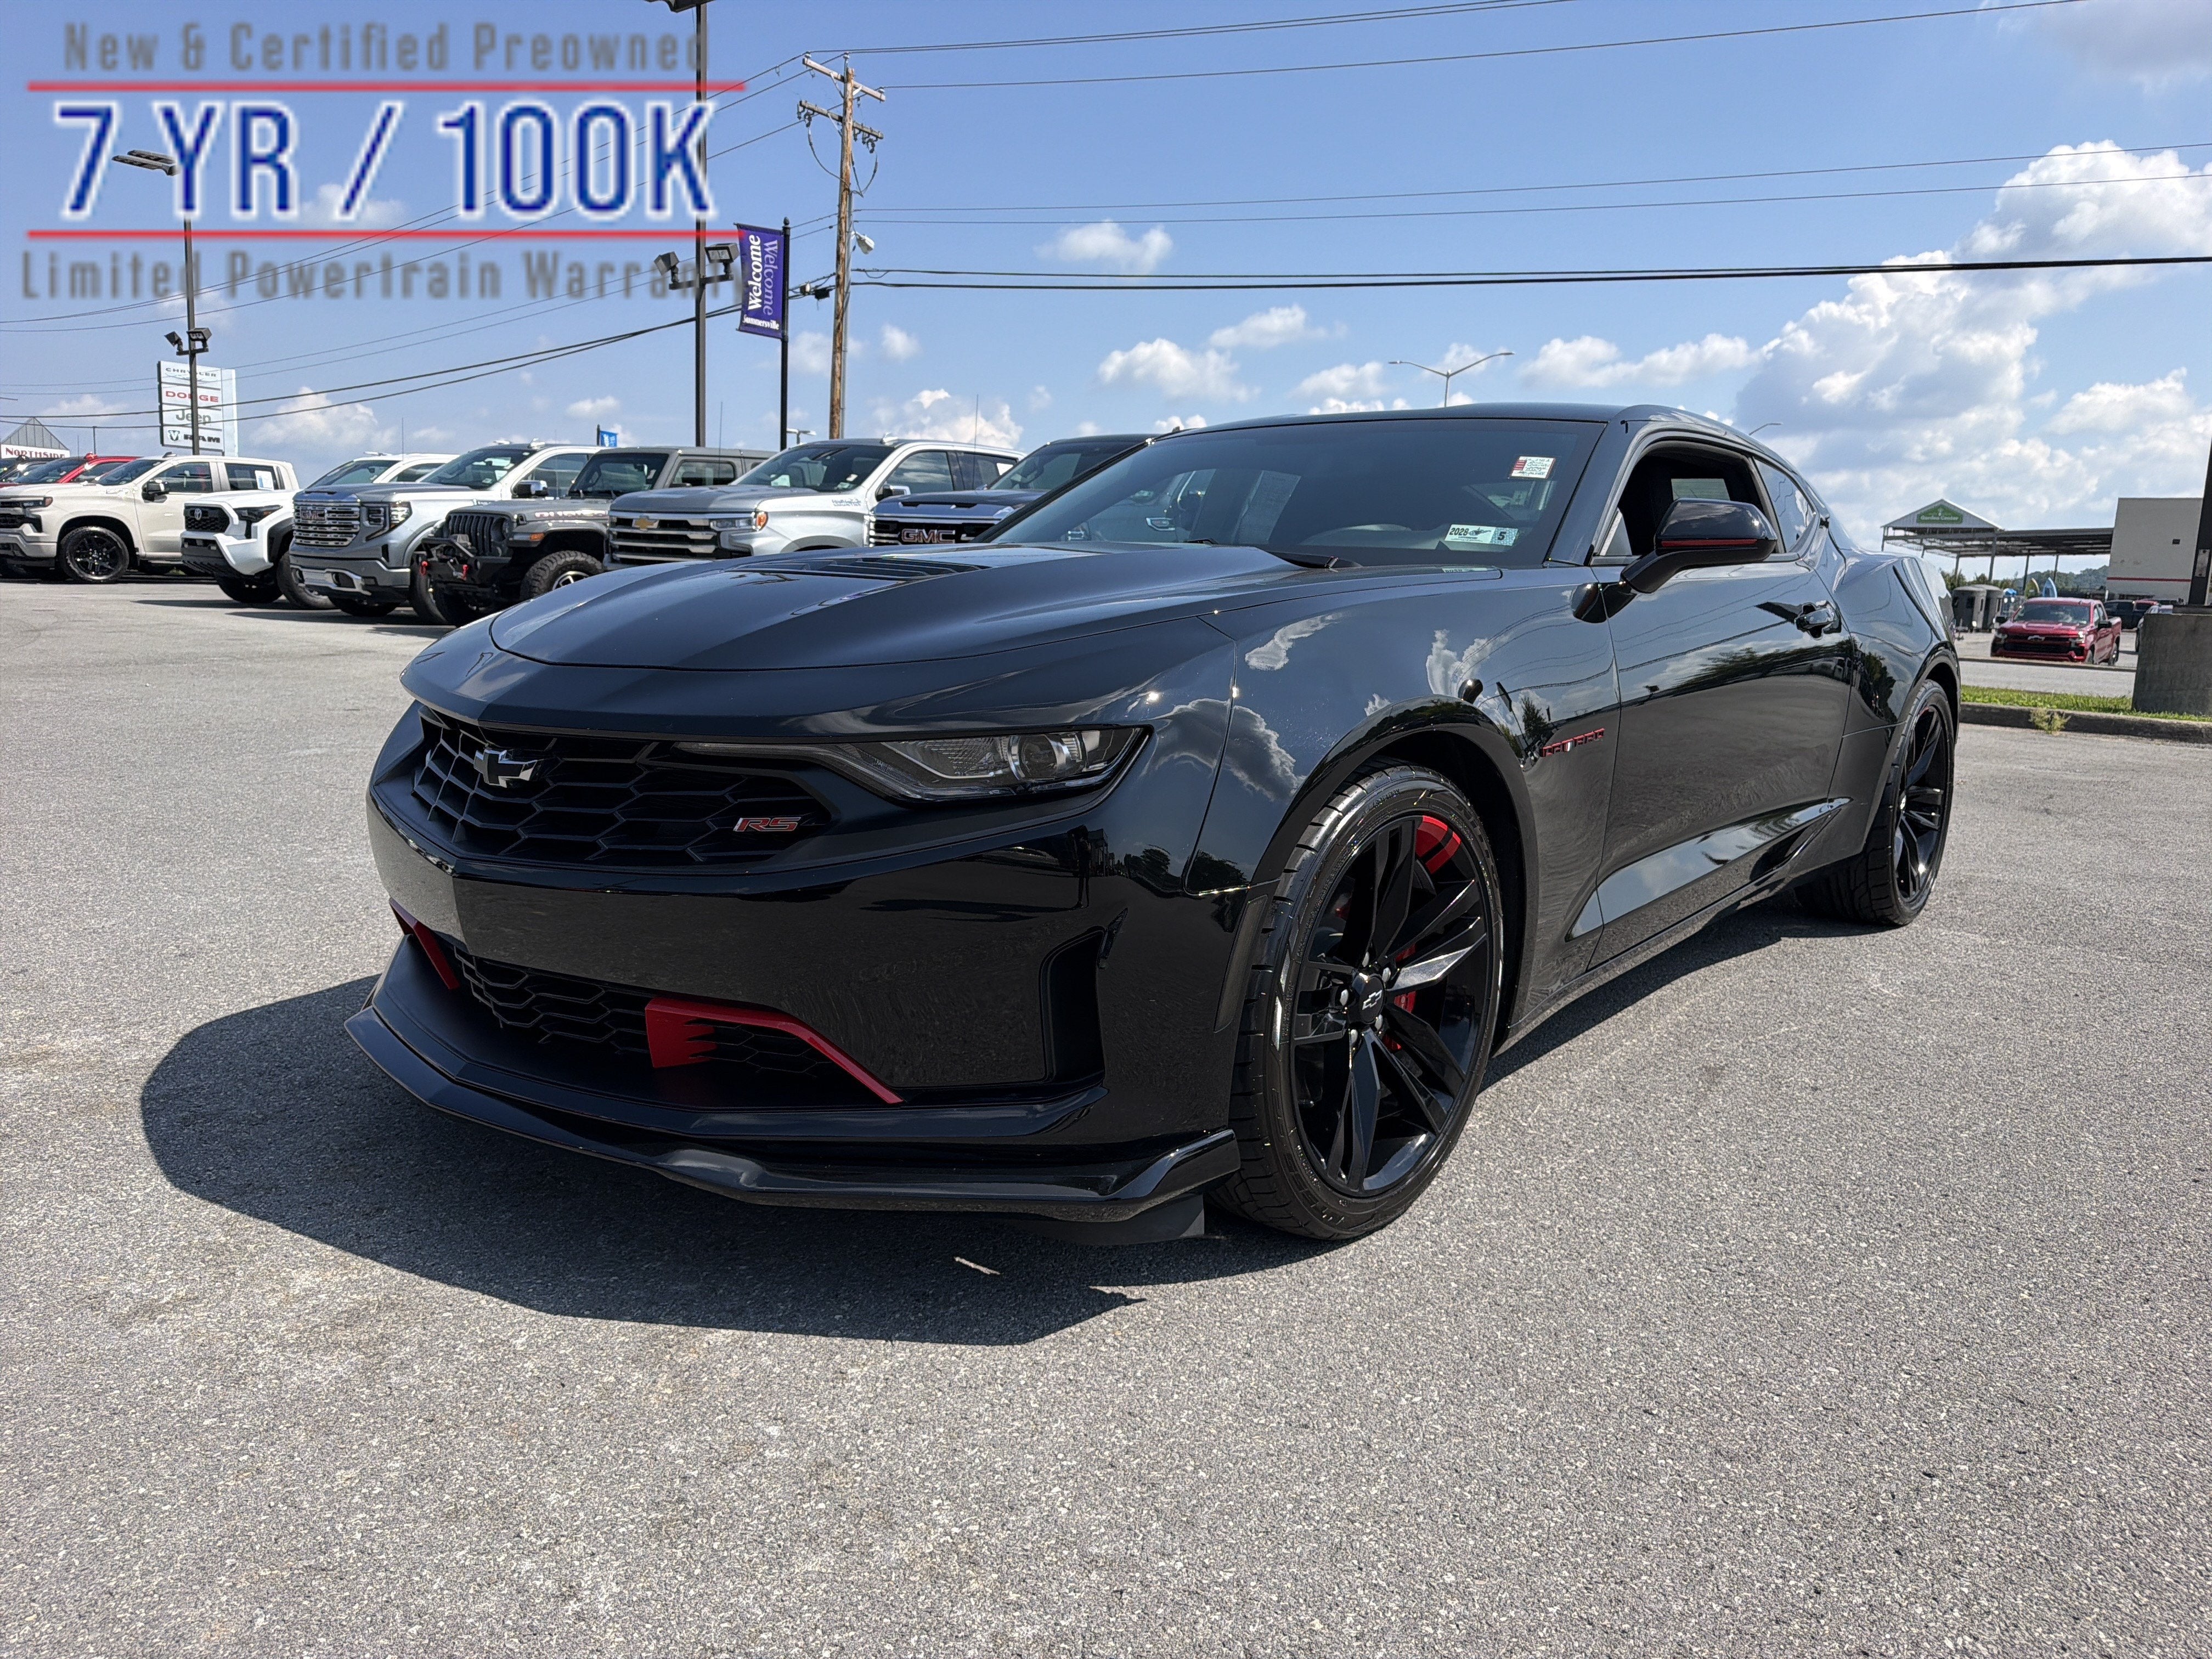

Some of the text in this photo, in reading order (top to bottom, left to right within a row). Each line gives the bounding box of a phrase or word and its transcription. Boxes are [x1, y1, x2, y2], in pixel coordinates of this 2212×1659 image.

[747, 234, 763, 311] Welcome
[763, 239, 778, 316] Welcome
[742, 314, 780, 330] Summersville
[901, 528, 956, 544] GMC
[1449, 527, 1506, 541] 2028 5
[733, 817, 802, 832] RS
